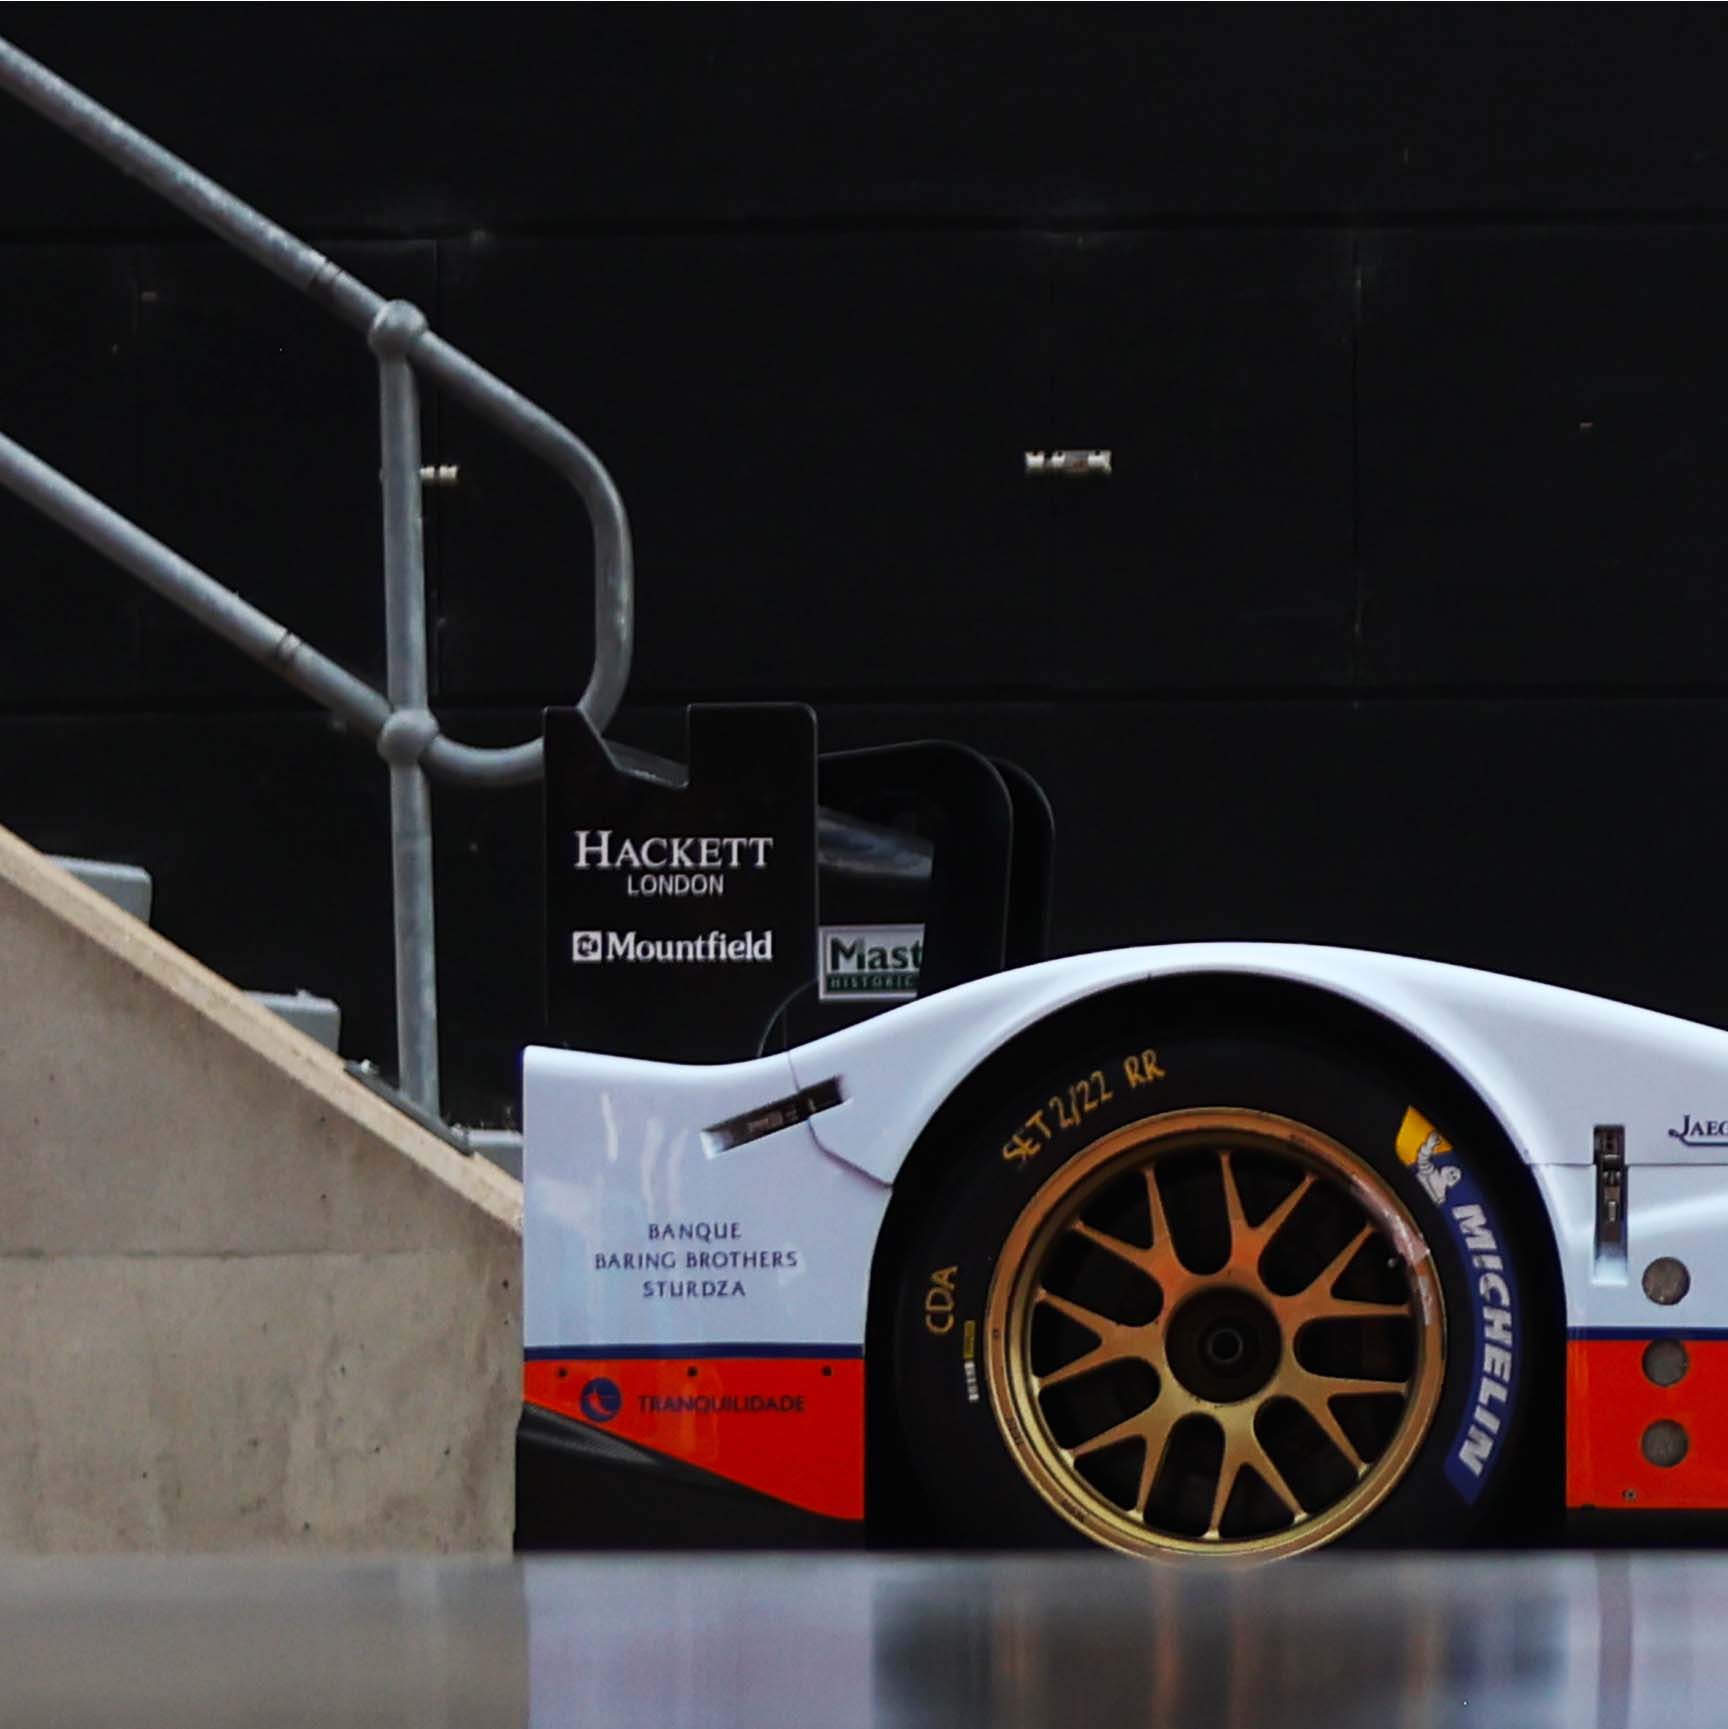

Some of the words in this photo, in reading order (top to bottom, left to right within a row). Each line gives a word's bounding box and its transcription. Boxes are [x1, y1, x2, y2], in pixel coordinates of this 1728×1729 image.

[573, 830, 773, 868] HACKETT
[627, 874, 724, 896] LONDON
[607, 931, 773, 962] Mountfield
[1002, 1110, 1052, 1162] SET
[1049, 1070, 1114, 1129] 2/22
[1123, 1049, 1166, 1088] RR
[648, 1222, 742, 1243] BANQUE
[595, 1251, 676, 1270] BARING
[686, 1250, 798, 1269] BROTHERS
[643, 1280, 746, 1298] STURDZA
[925, 1265, 959, 1334] CDA
[1452, 1204, 1513, 1478] MICHELIN
[637, 1395, 805, 1413] TRANQUILIDADE
